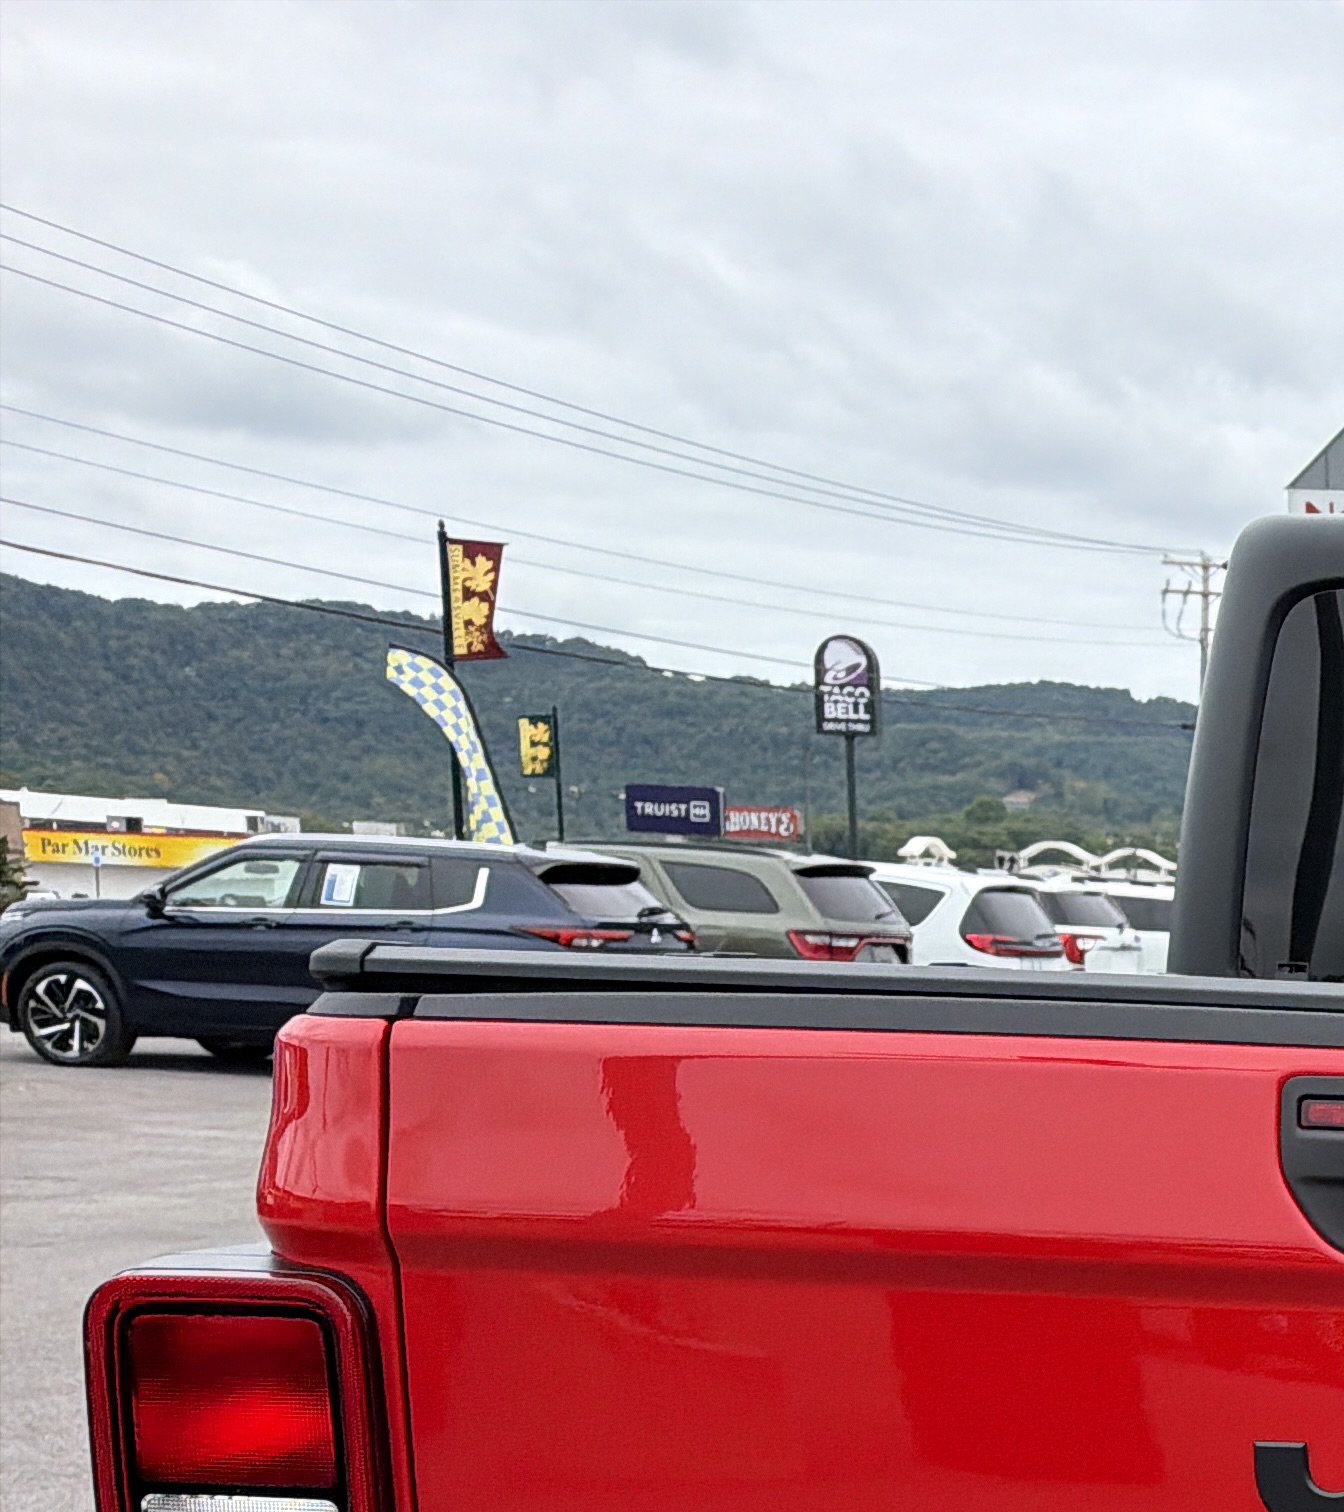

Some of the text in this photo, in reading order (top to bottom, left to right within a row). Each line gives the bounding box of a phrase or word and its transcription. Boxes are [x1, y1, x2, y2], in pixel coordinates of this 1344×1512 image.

[819, 685, 870, 703] TACO
[823, 702, 871, 720] BELL
[634, 801, 688, 818] TRUIST
[40, 837, 161, 859] Par Mar Stores
